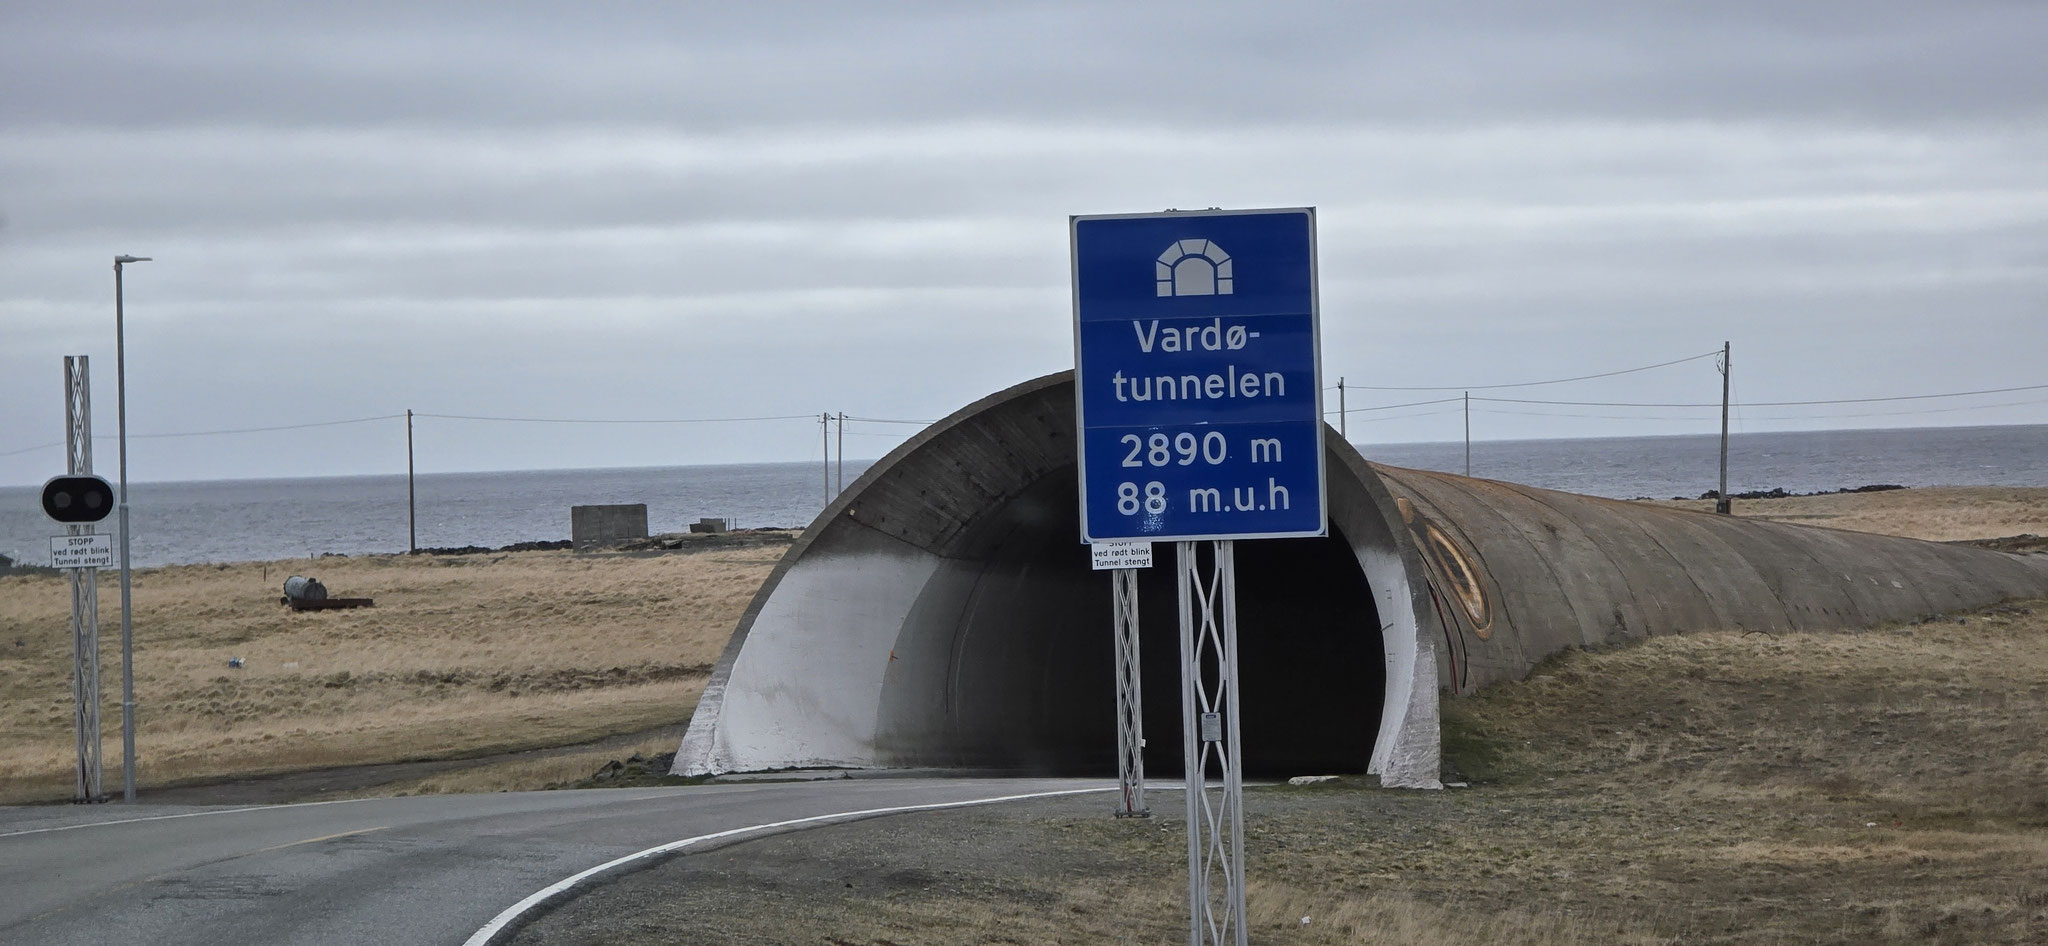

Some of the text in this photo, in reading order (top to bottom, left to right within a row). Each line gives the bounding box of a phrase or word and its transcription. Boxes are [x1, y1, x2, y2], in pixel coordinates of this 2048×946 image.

[1133, 318, 1260, 352] Vardø-
[1113, 365, 1284, 401] tunnelen
[1120, 431, 1282, 467] 2890 m
[1117, 478, 1290, 515] 88 m.u.h
[53, 546, 109, 556] ved rødt blink
[68, 538, 94, 546] STOPP
[84, 556, 109, 564] stengt
[1125, 558, 1150, 566] stengt
